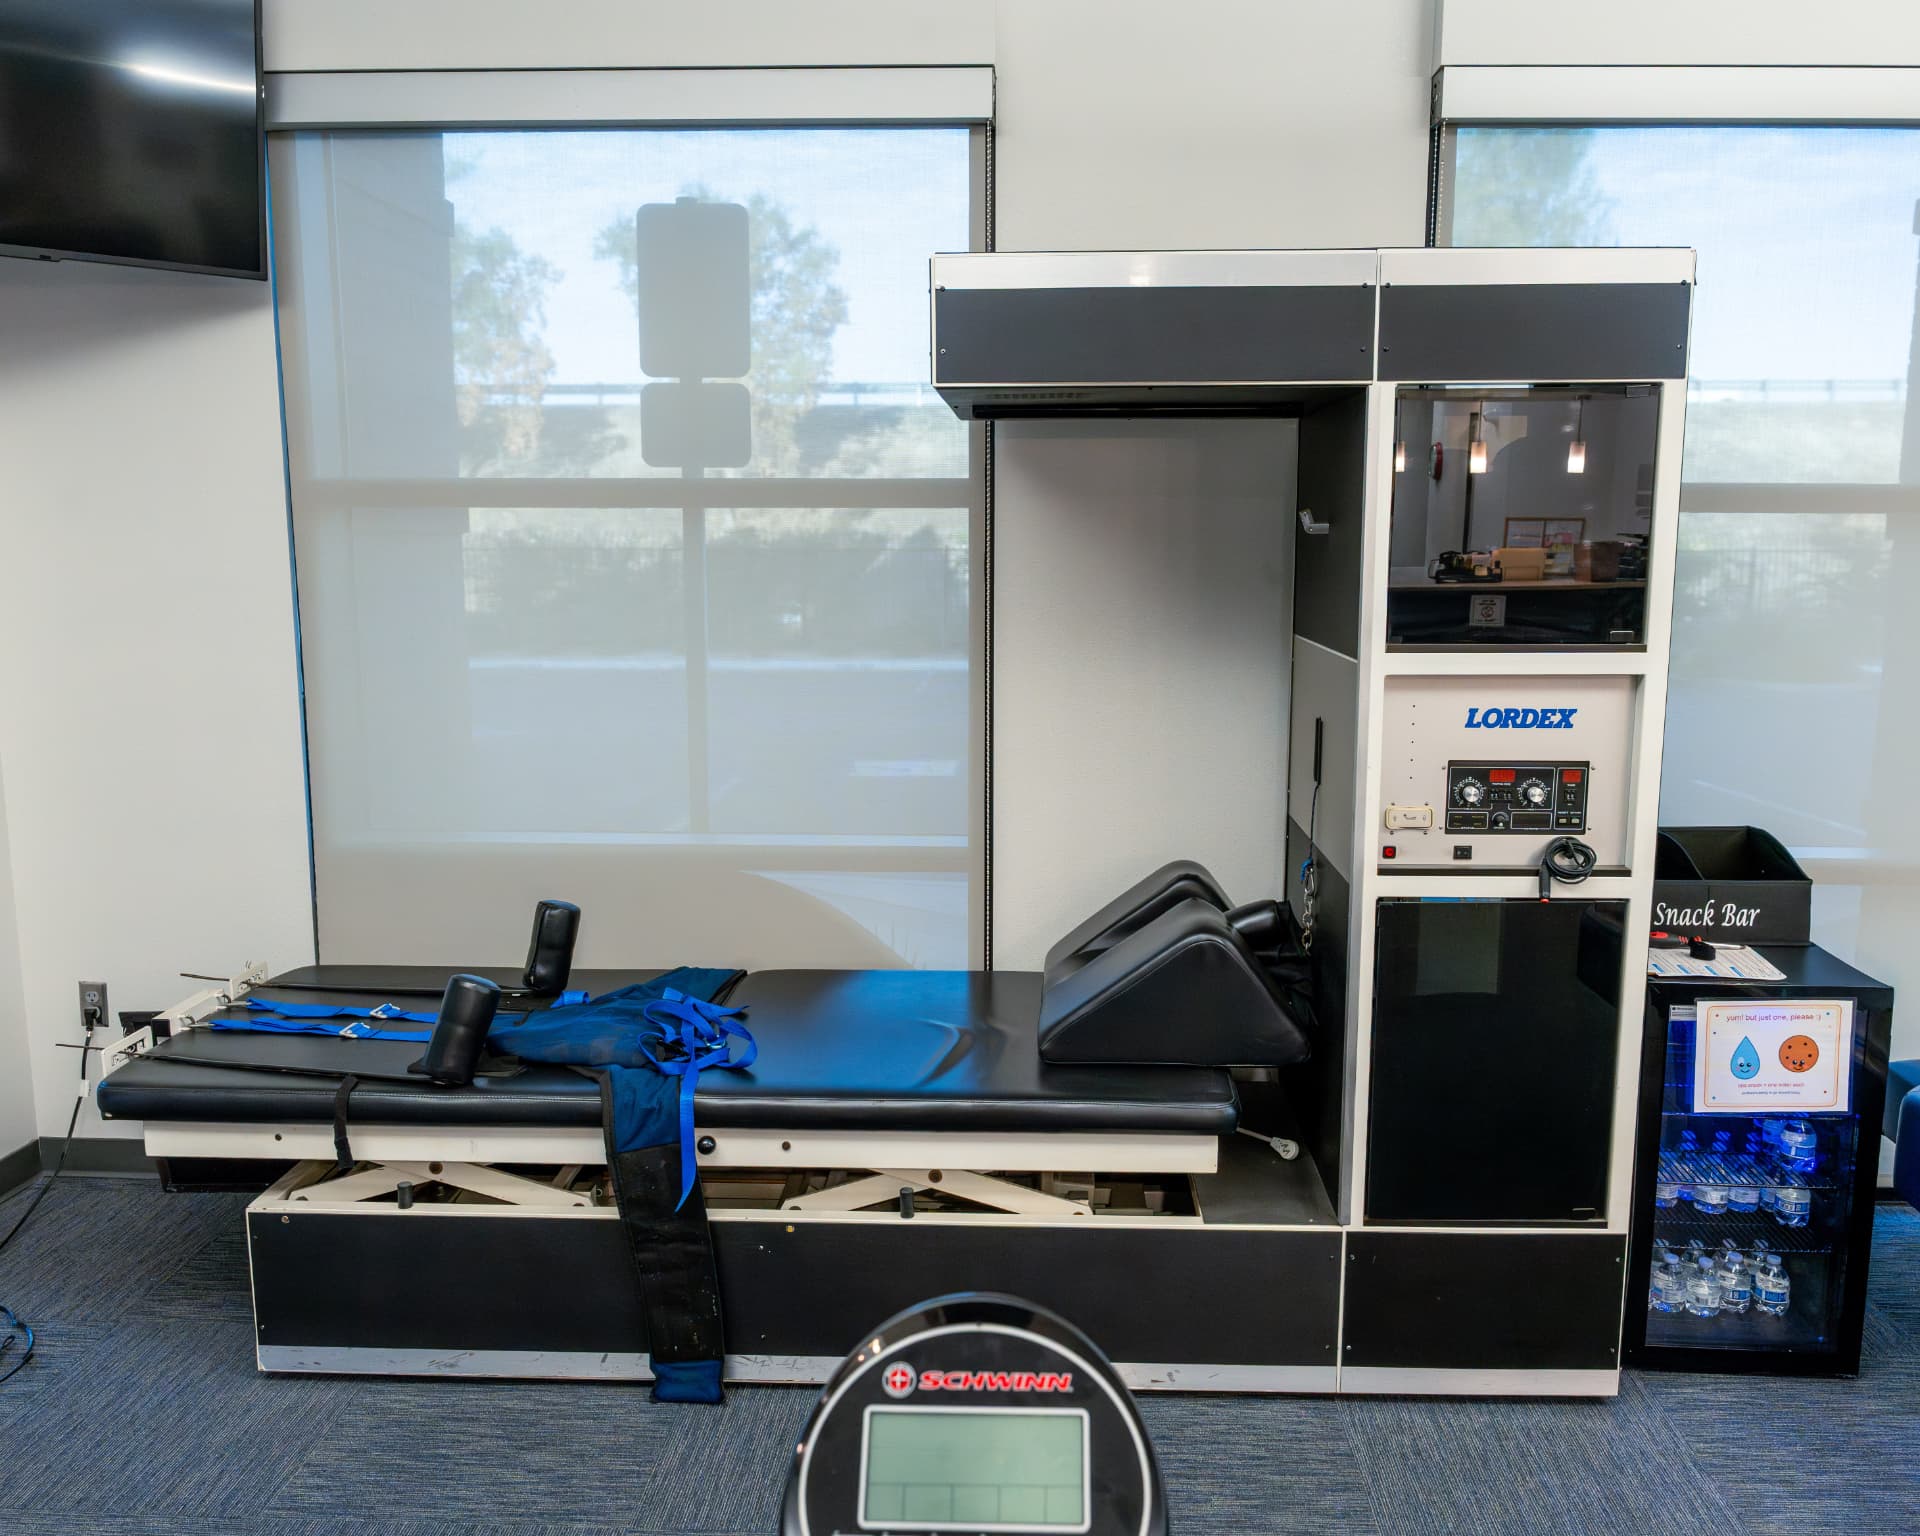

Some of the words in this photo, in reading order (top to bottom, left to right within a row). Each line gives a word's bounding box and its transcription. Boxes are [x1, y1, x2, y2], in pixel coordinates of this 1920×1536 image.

[1465, 708, 1577, 728] LORDEX
[1654, 900, 1715, 927] Snack
[1721, 903, 1761, 926] Bar
[1745, 1013, 1757, 1021] but
[1758, 1013, 1771, 1022] just
[1790, 1013, 1814, 1022] please
[918, 1370, 1073, 1392] SCHWINN
